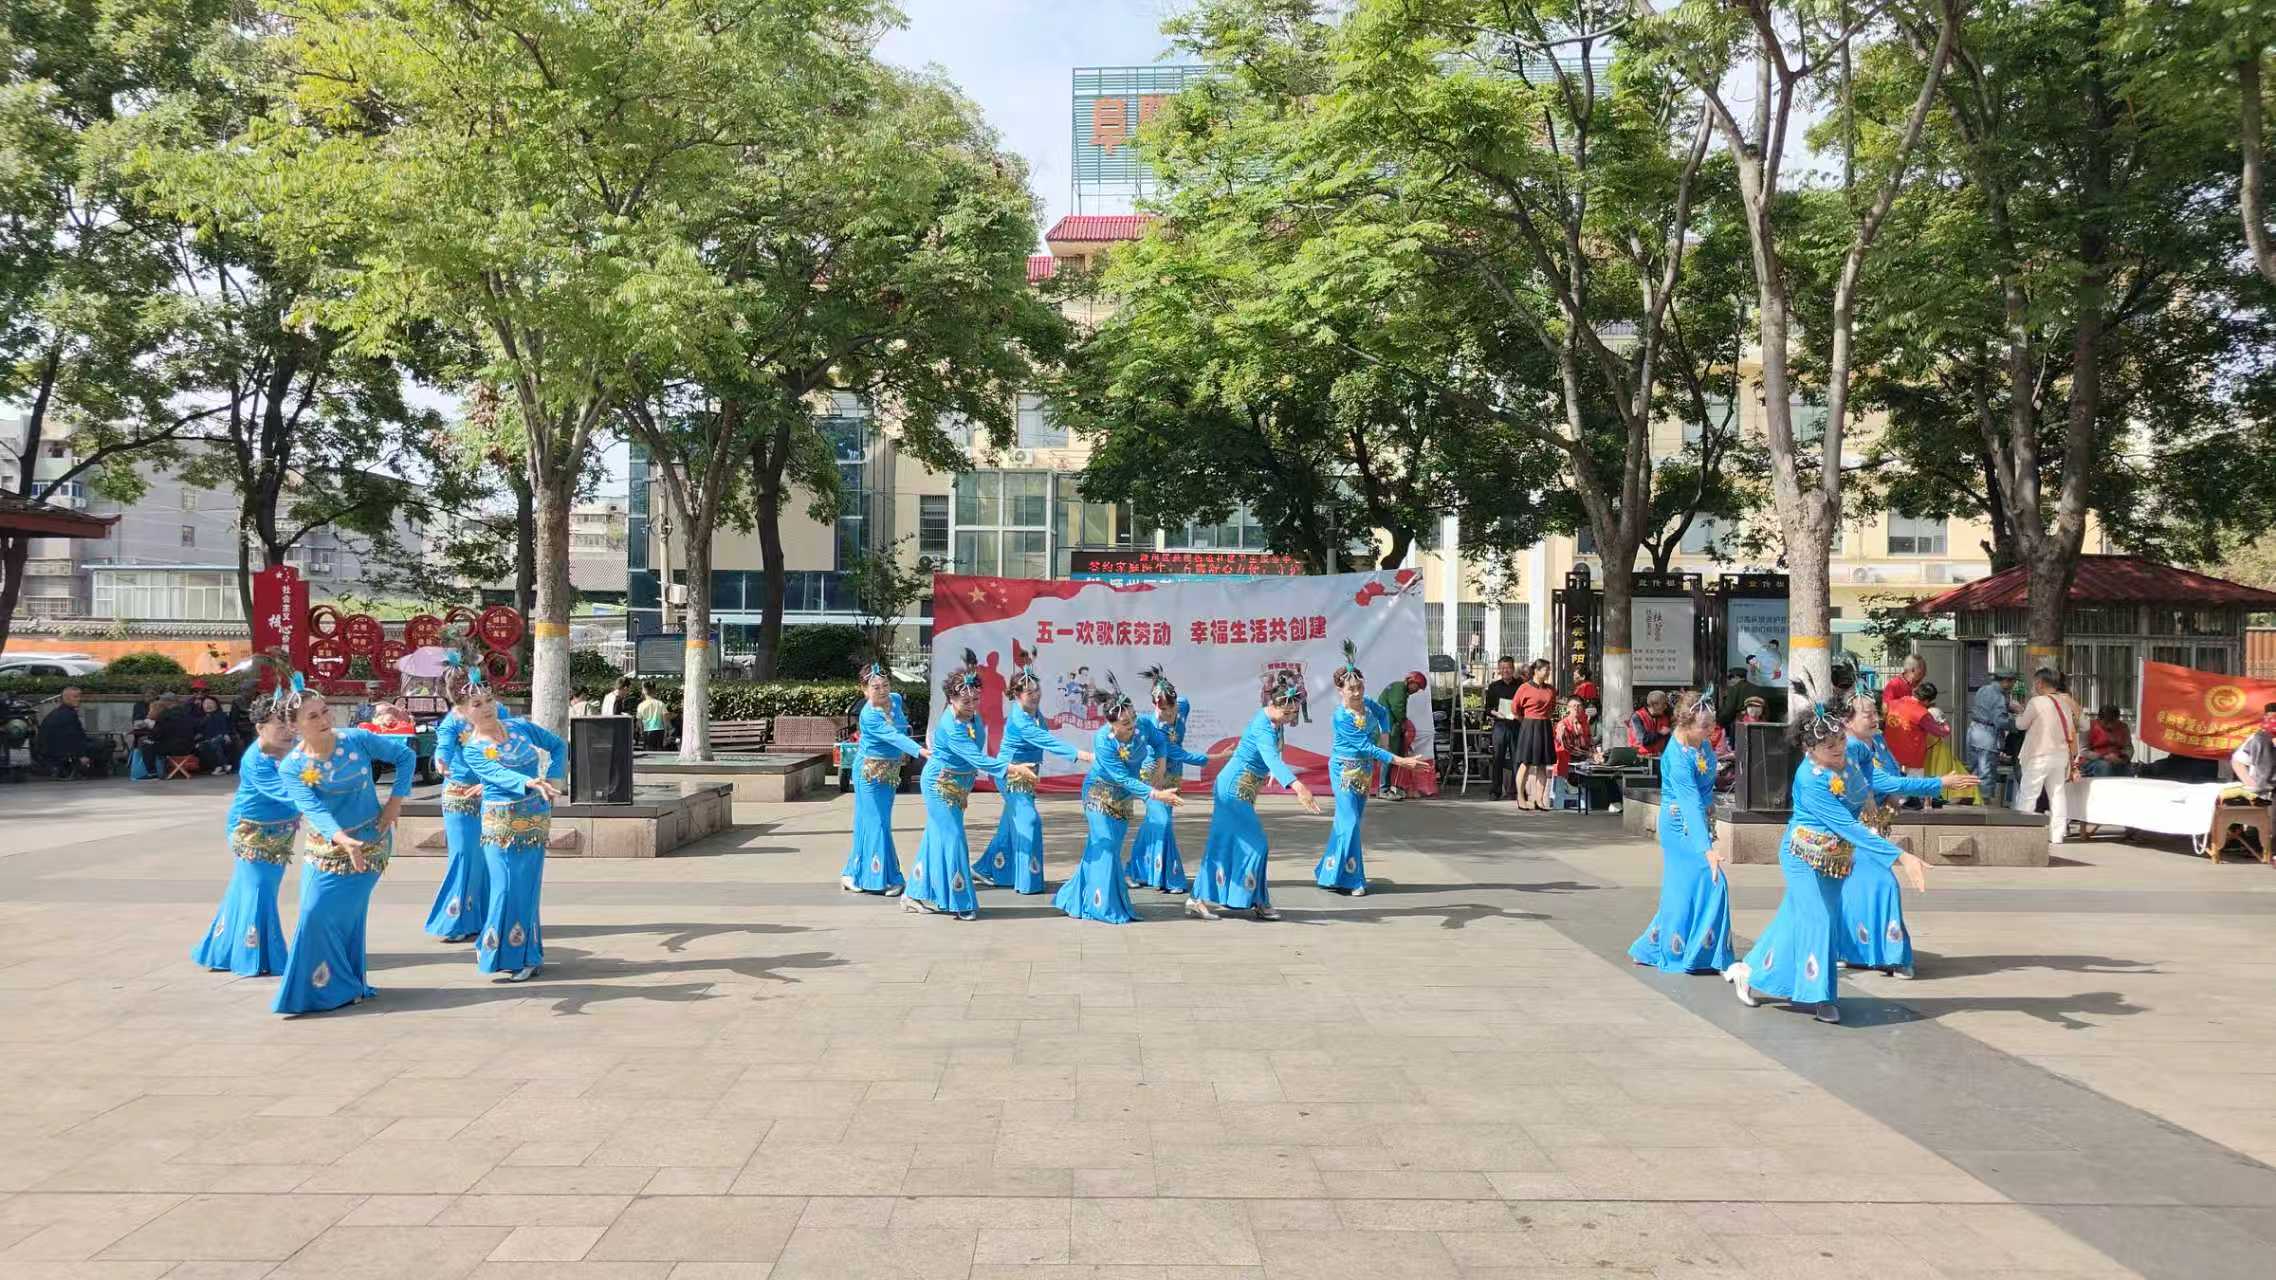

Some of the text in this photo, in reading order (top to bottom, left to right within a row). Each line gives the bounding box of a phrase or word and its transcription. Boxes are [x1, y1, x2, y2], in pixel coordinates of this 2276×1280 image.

[1036, 615, 1327, 646] 五一欢歌庆劳动 幸福生活共创建
